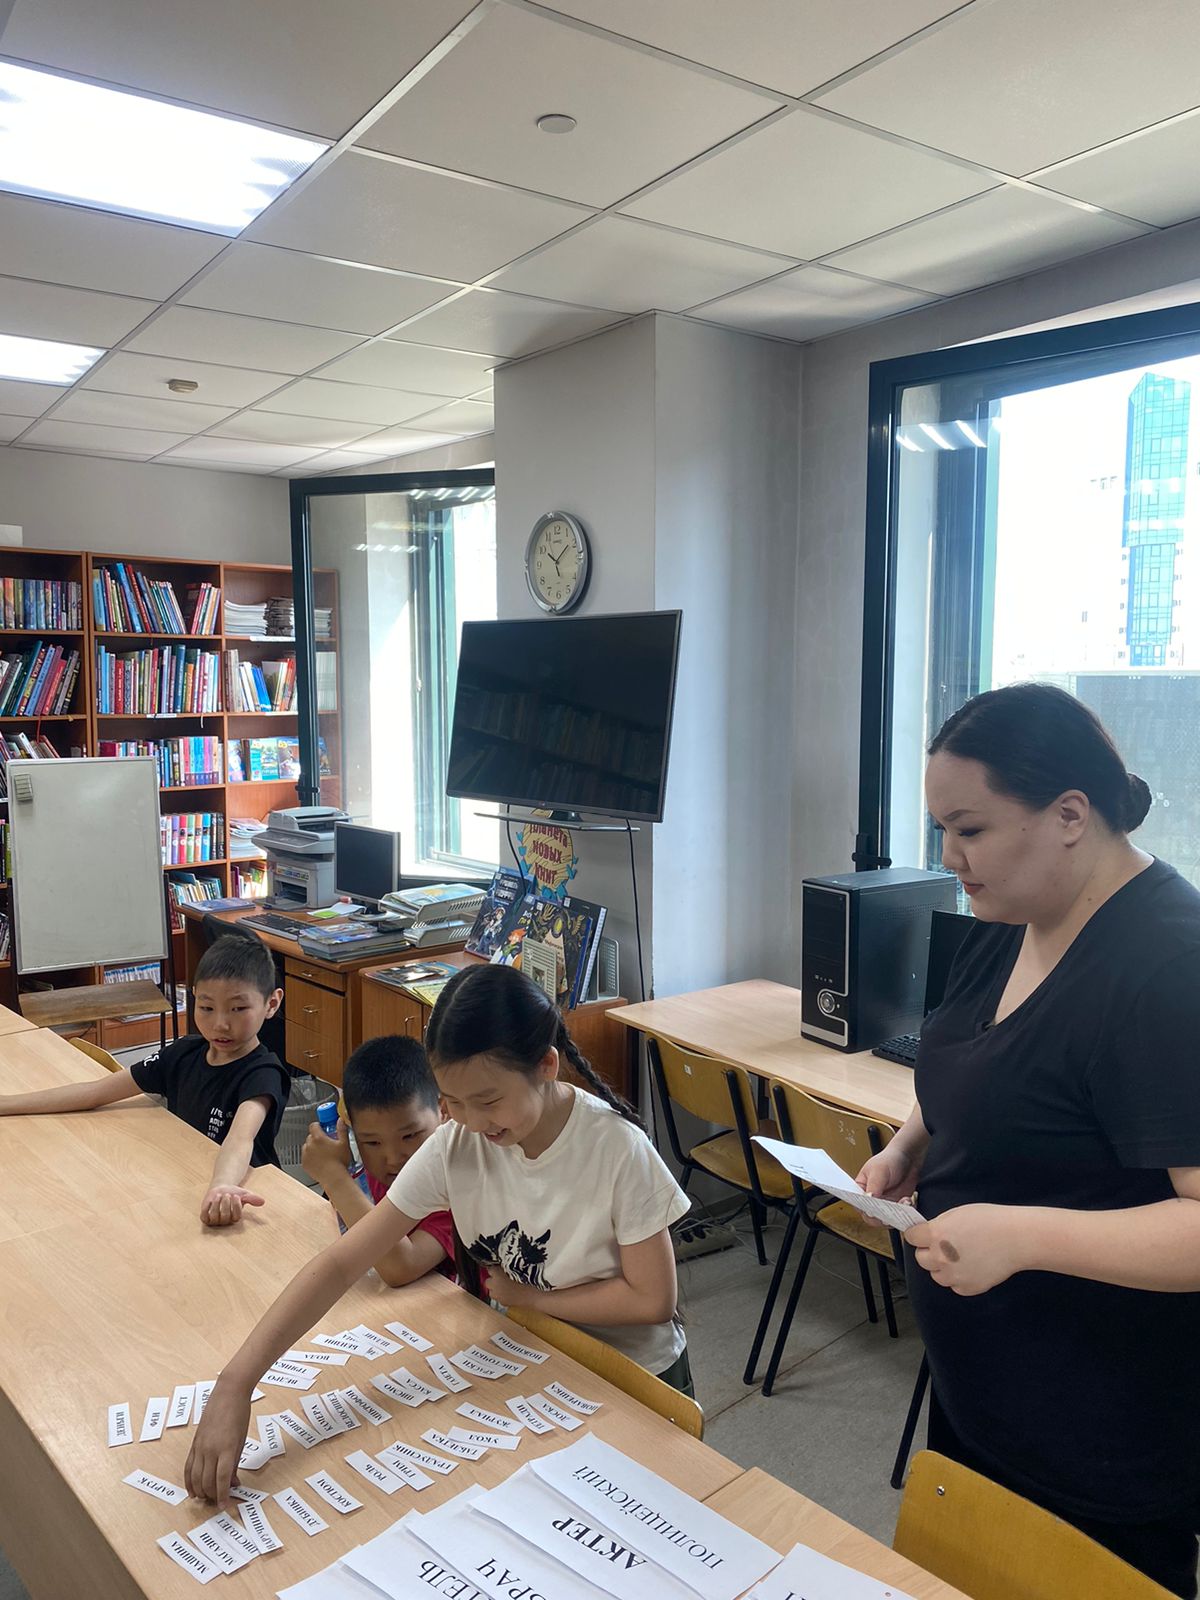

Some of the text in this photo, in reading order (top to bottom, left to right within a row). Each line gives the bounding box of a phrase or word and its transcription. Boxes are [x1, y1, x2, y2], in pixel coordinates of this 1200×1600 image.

[545, 531, 551, 541] 11
[553, 525, 560, 535] 12
[540, 545, 546, 554] 10
[537, 561, 541, 569] 9
[540, 576, 545, 585] 8
[566, 584, 571, 594] 5
[547, 586, 552, 596] 7
[556, 591, 561, 599] 6
[324, 1338, 358, 1351] БЕНЗИН
[401, 1330, 419, 1343] РУЛЬ
[498, 1336, 543, 1360] НОЖНИЦЫ
[462, 1360, 496, 1376] КРАСКИ
[471, 1350, 519, 1372] КИСТОЧКИ
[267, 1375, 298, 1385] ВЕДРО
[438, 1364, 460, 1387] ГАЗЕТА
[406, 1378, 432, 1395] КАССА
[175, 1396, 188, 1418] ХОЛСТ
[345, 1389, 384, 1421] МИКРОФОН
[542, 1403, 569, 1422] ДОСКА
[149, 1412, 160, 1427] ФЕН
[311, 1404, 334, 1432] КАМЕРА
[470, 1409, 510, 1428] ЖУРНАЛ
[265, 1422, 279, 1449] БУМАГА
[279, 1414, 317, 1444] ТЕЛЕВИЗОР
[468, 1434, 499, 1444] УКОЛ
[431, 1433, 478, 1456] ТАБЛЕТКА
[392, 1445, 452, 1470] ГРАДУСНИК
[366, 1464, 387, 1482] РОЛЬ
[392, 1459, 417, 1478] ГРИМ
[137, 1476, 175, 1497] ФАРТУК
[317, 1478, 352, 1508] КОСТЮМ
[285, 1495, 320, 1527] ДУБИНКА
[572, 1465, 724, 1569] ПОЛИЦЕЙСКИЙ
[216, 1518, 259, 1553] ПИСТОЛЕТ
[245, 1502, 277, 1550] НАРУЧНИКИ
[200, 1532, 237, 1566] МАГАЗИН
[552, 1517, 648, 1570] АКТЕР
[170, 1540, 209, 1574] МАШИНА
